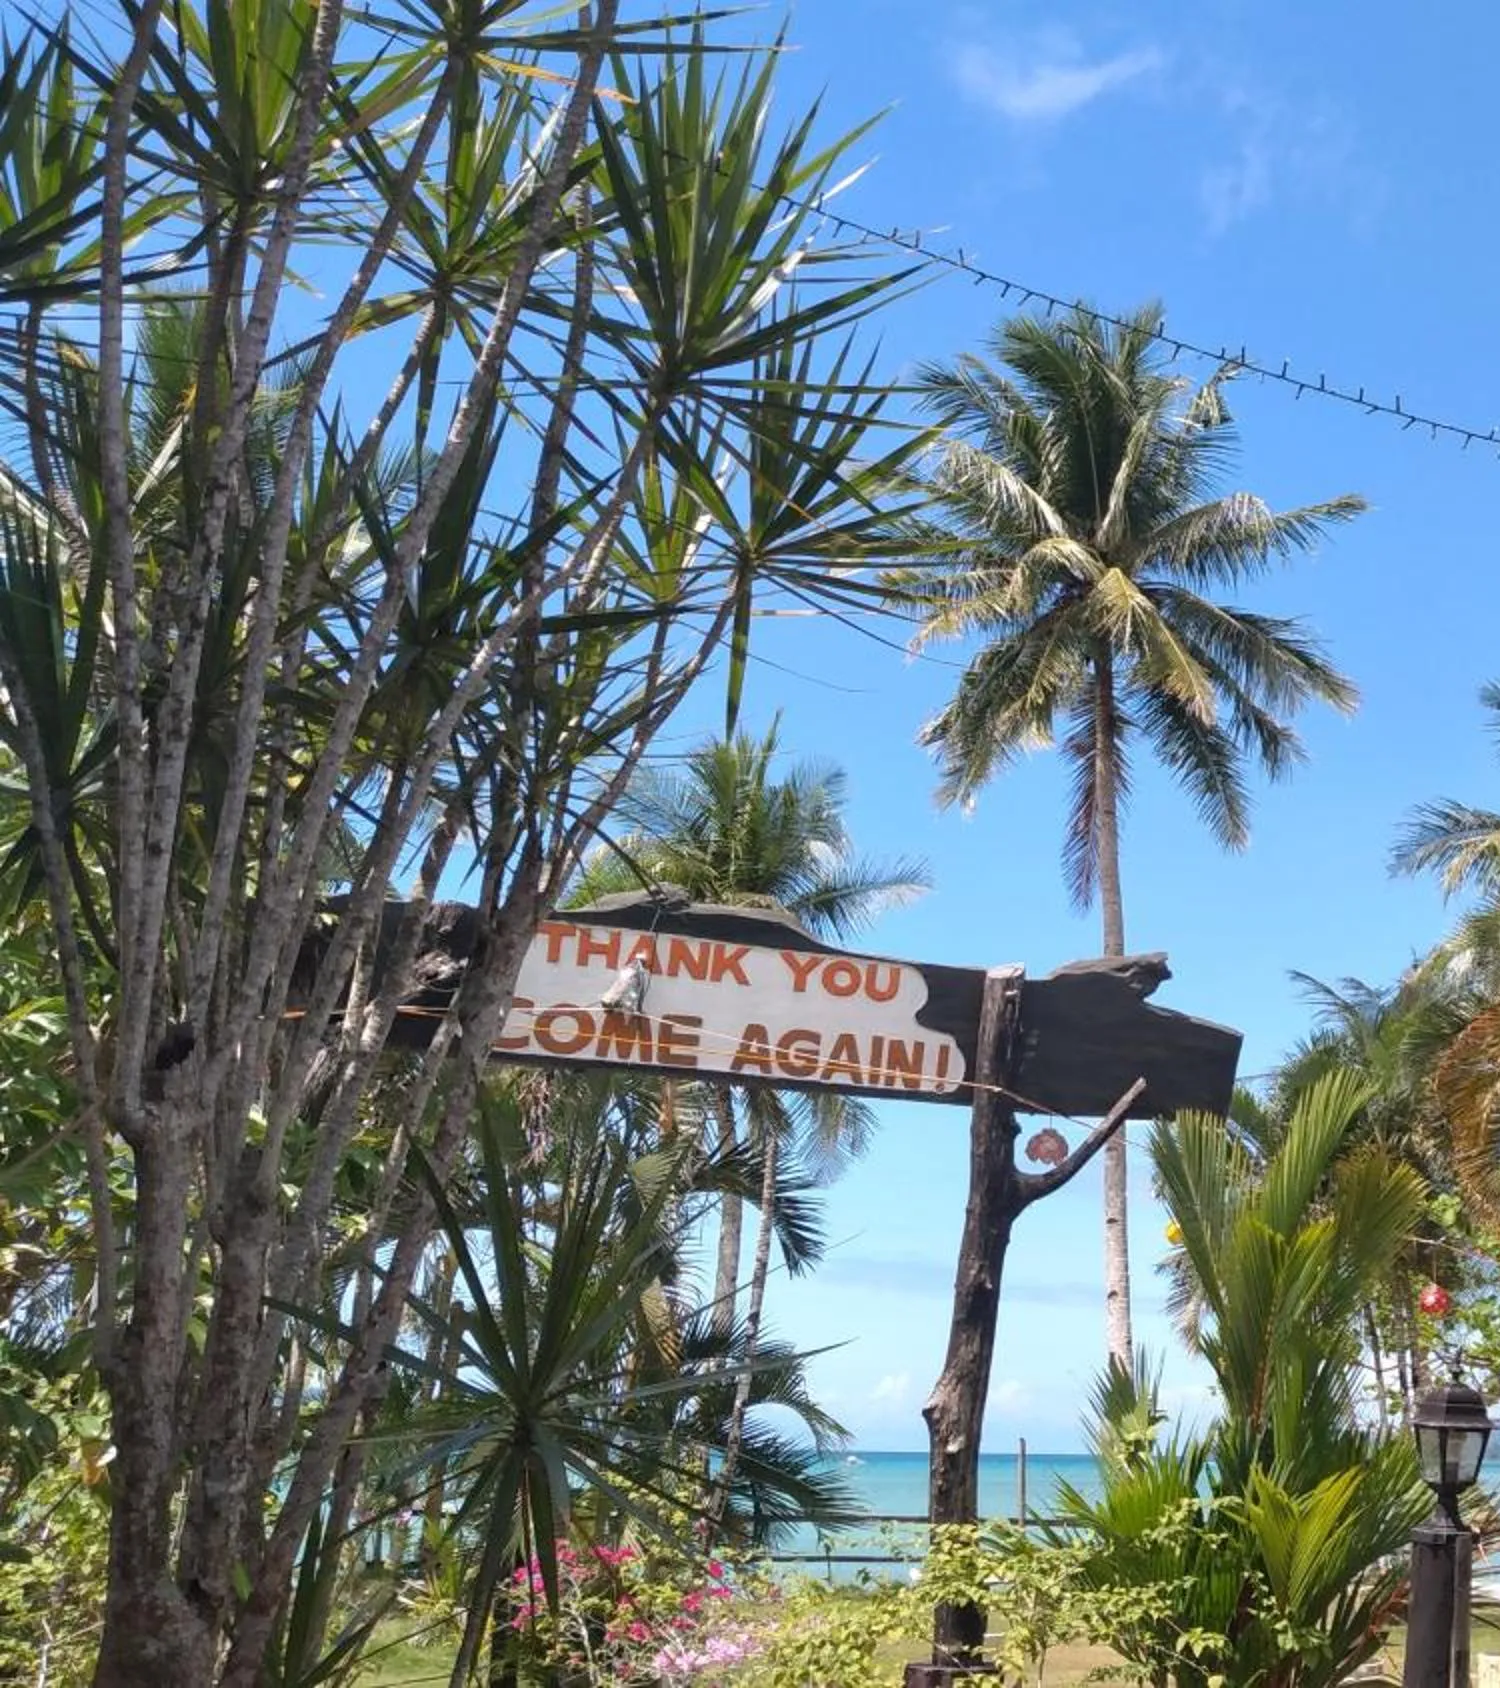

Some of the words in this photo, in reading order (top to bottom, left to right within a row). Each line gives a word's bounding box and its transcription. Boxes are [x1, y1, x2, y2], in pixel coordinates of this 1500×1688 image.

[537, 921, 752, 986] THANK
[779, 950, 901, 1002] YOU
[729, 1023, 952, 1095] AGAIN!
